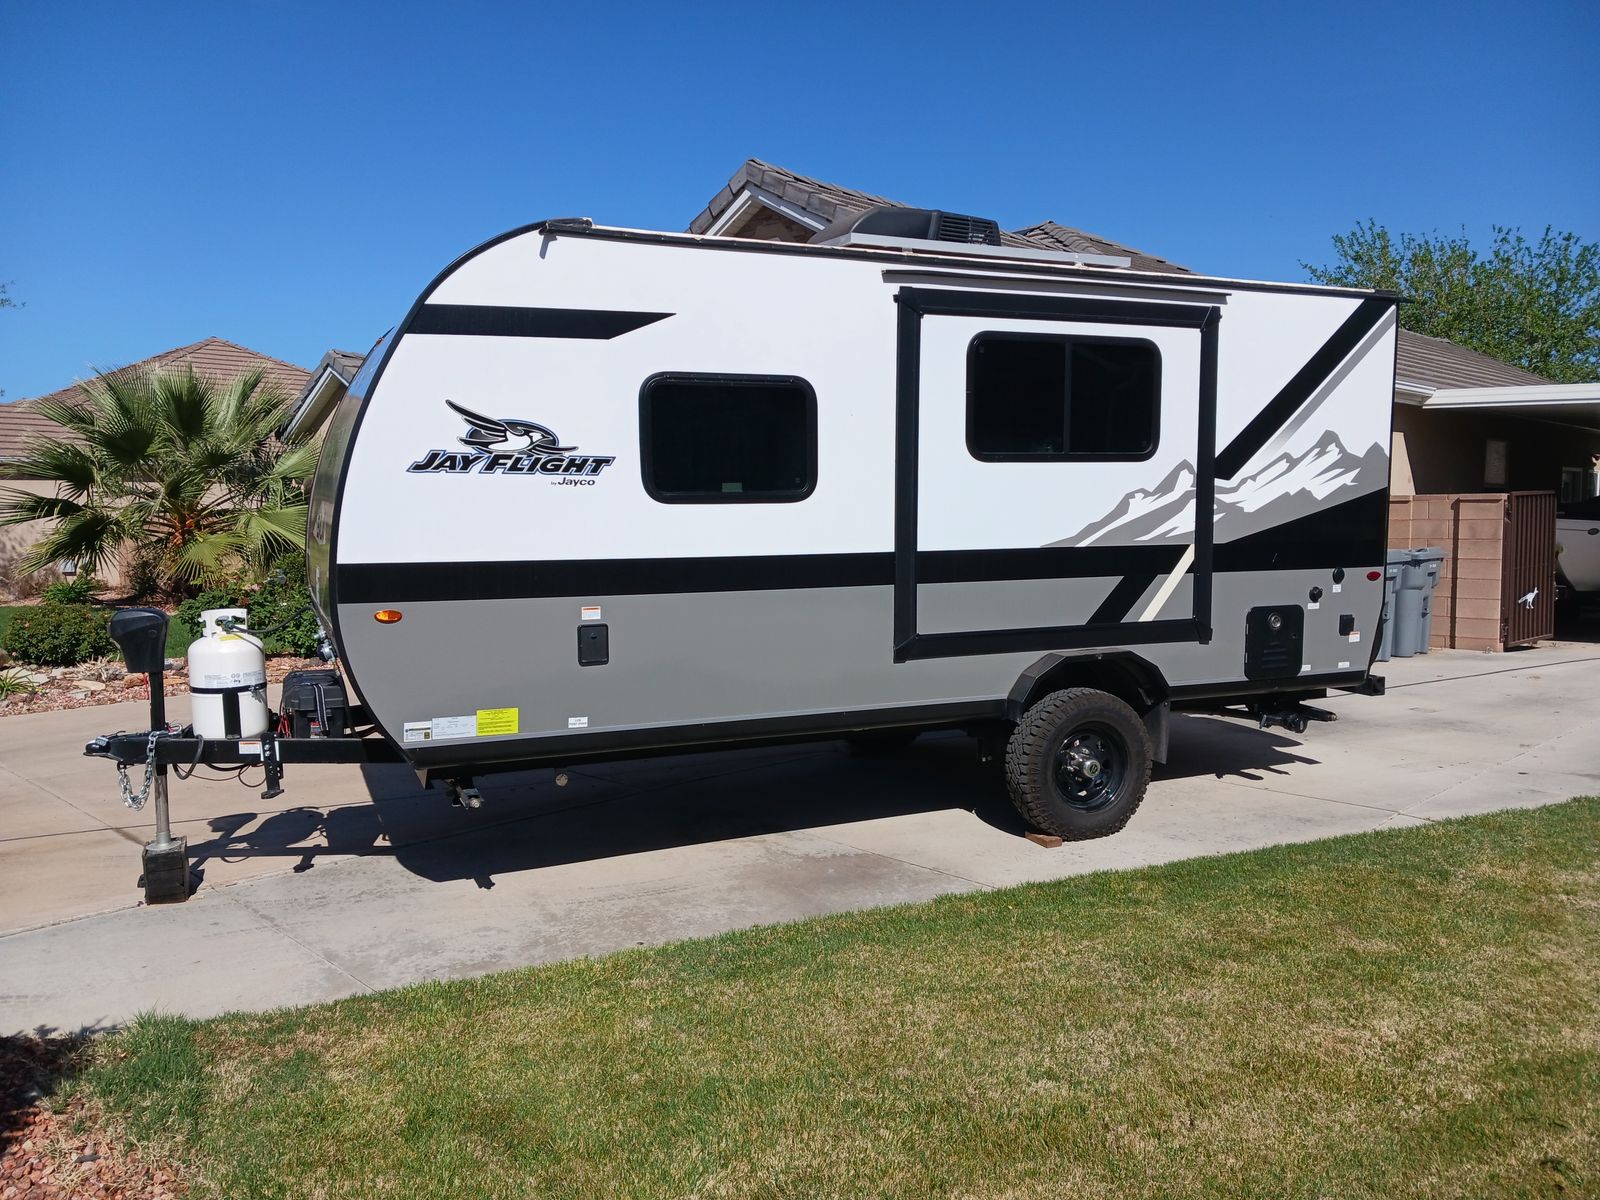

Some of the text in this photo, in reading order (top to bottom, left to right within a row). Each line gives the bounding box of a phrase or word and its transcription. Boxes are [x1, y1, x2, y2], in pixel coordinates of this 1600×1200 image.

[407, 450, 615, 476] JAY FLIGHT
[557, 476, 596, 487] Jayco
